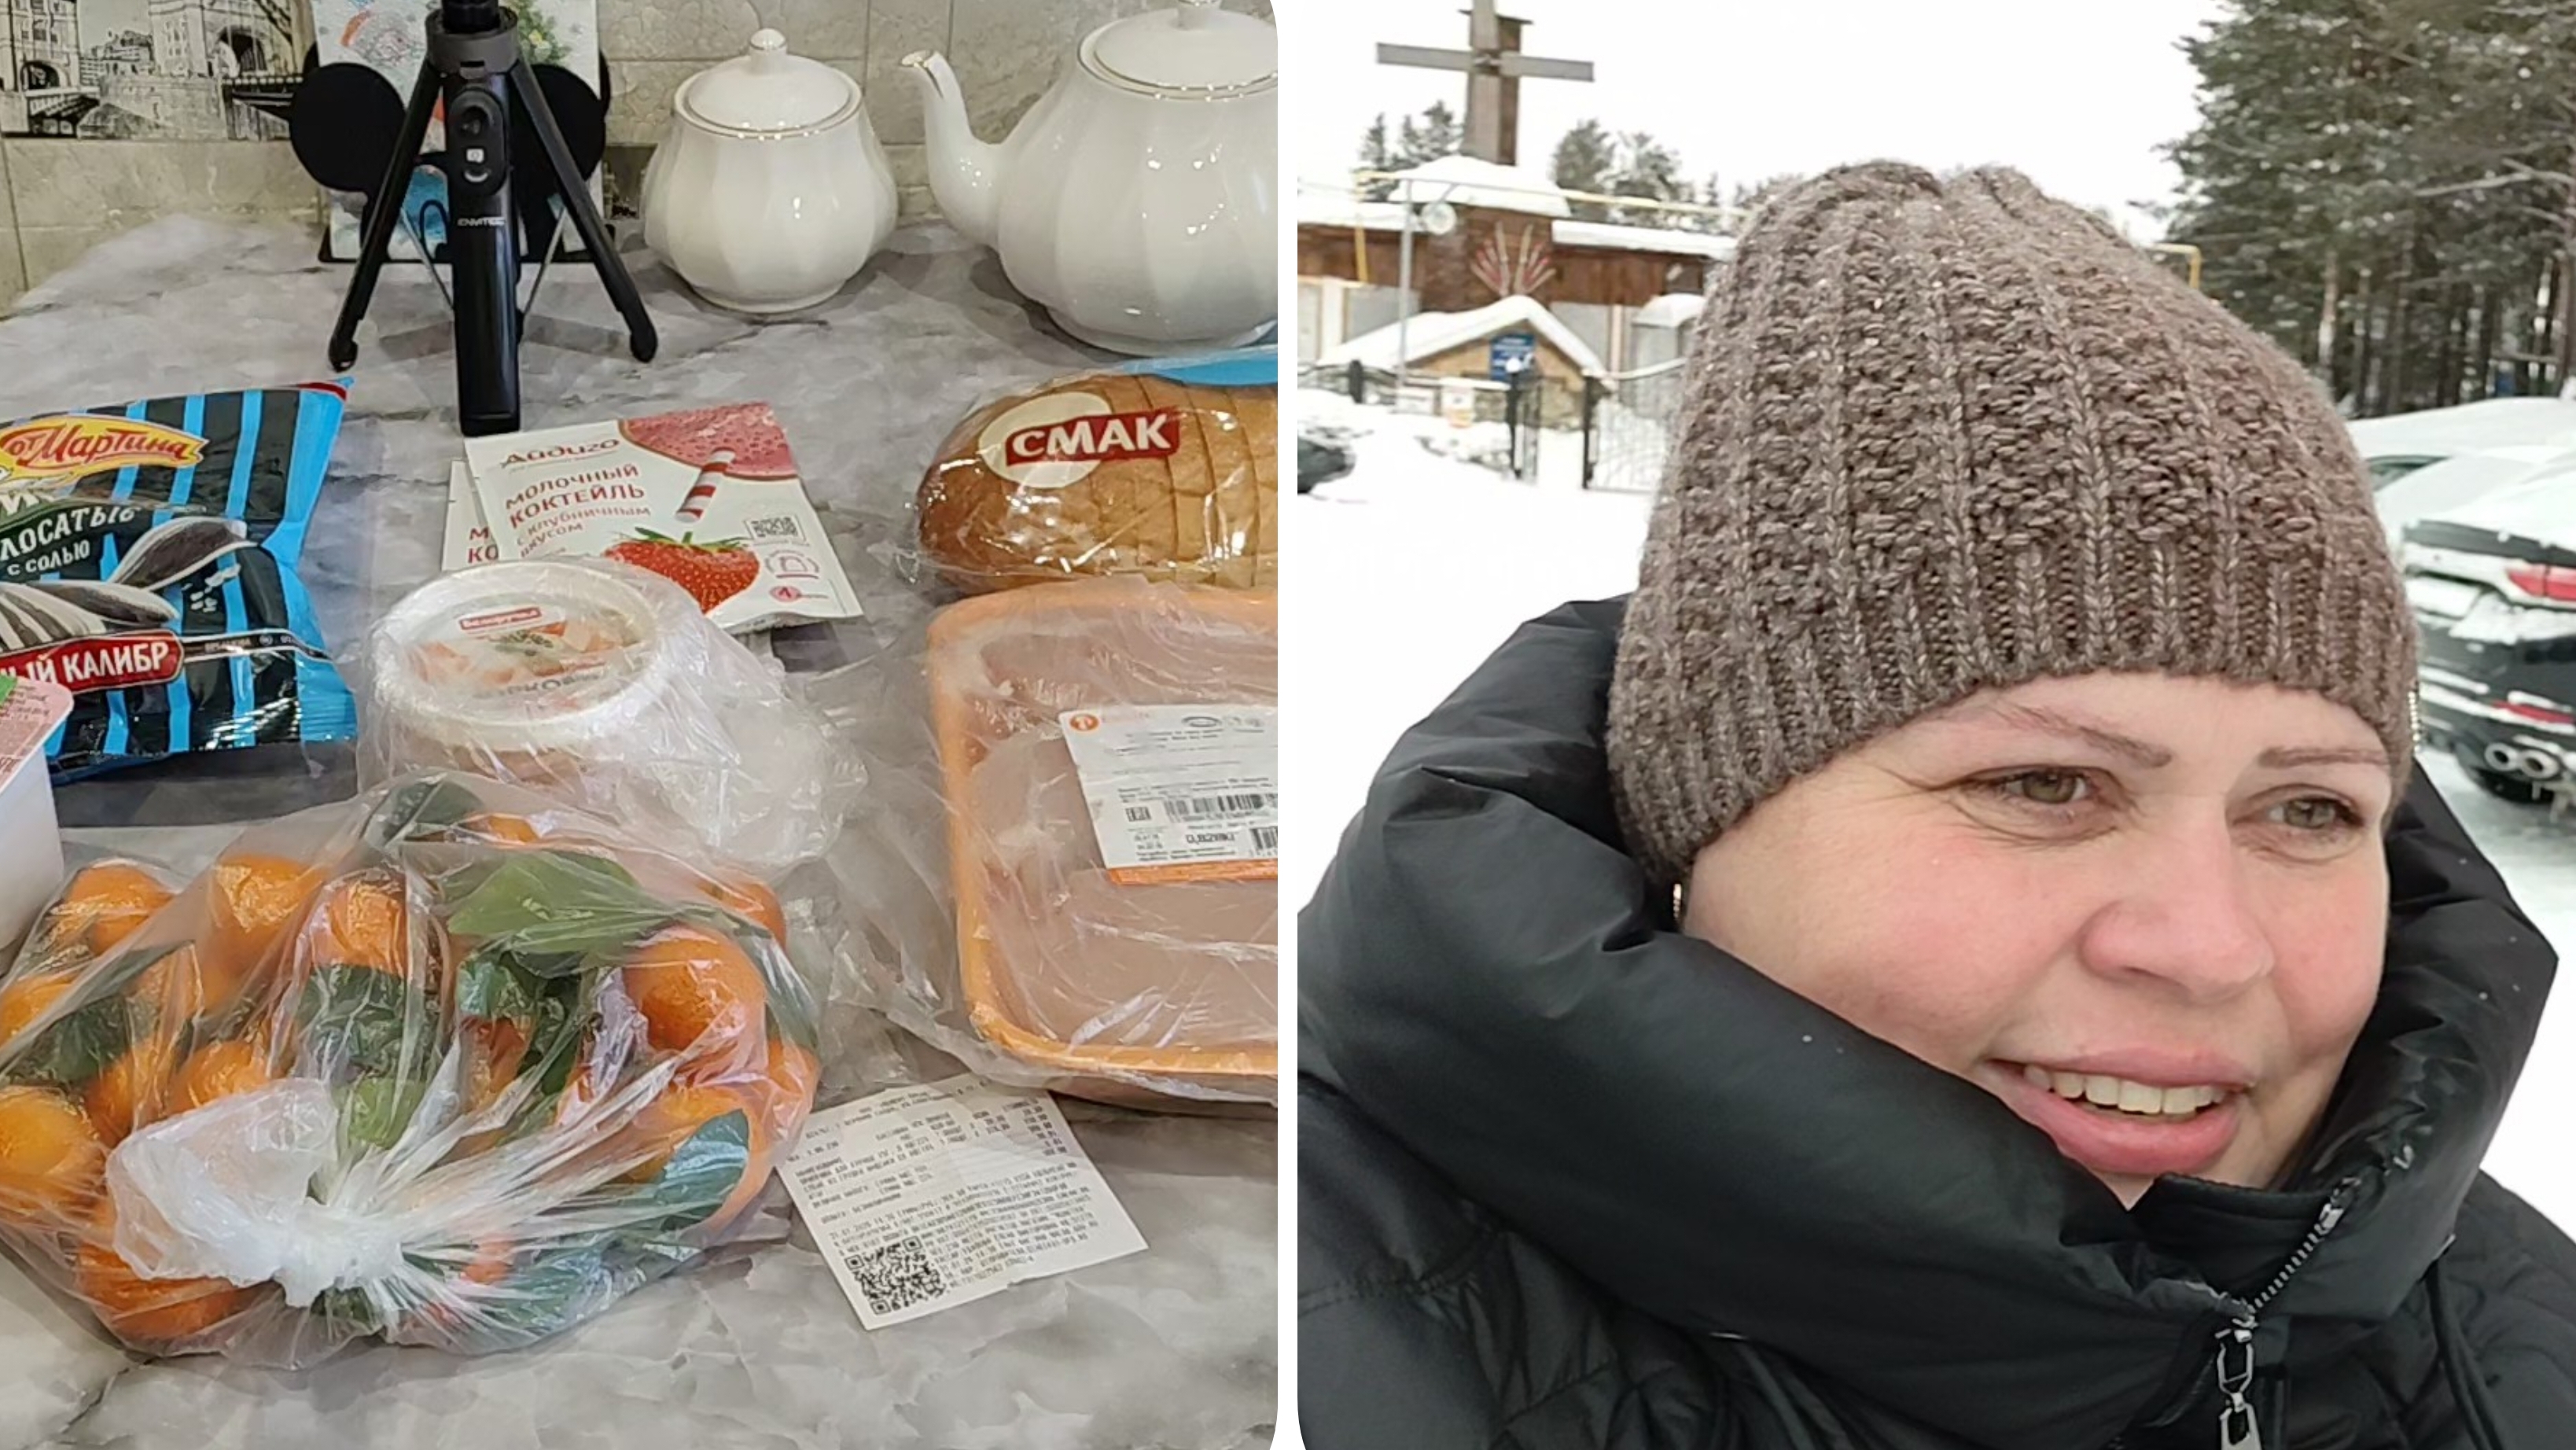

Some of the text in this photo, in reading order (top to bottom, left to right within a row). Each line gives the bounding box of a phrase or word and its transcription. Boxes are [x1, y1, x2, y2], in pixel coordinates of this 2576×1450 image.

[33, 424, 190, 466] Мартина
[1011, 414, 1172, 458] СМАК
[505, 463, 640, 510] МОЛОЧНЫЙ
[510, 484, 646, 529] КОКТЕЙЛЬ
[62, 641, 169, 683] КАЛИБР
